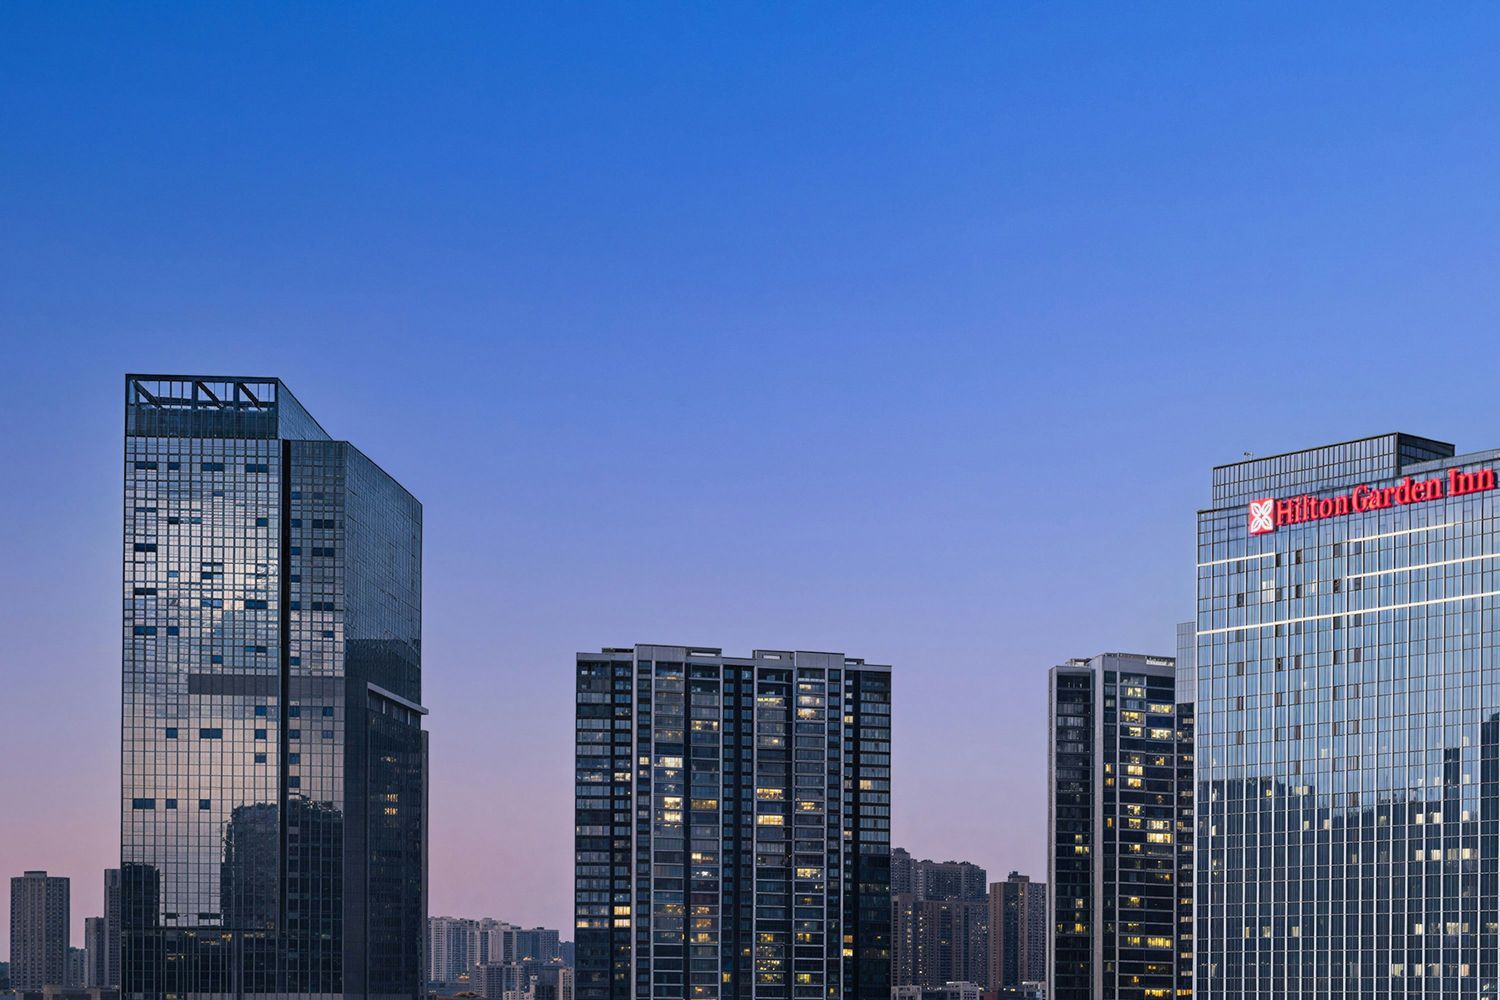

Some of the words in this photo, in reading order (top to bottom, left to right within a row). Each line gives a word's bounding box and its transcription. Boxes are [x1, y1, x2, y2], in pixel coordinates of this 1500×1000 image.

[1276, 495, 1348, 526] Hilton
[1352, 476, 1441, 512] Garden
[1448, 467, 1495, 497] Inn
